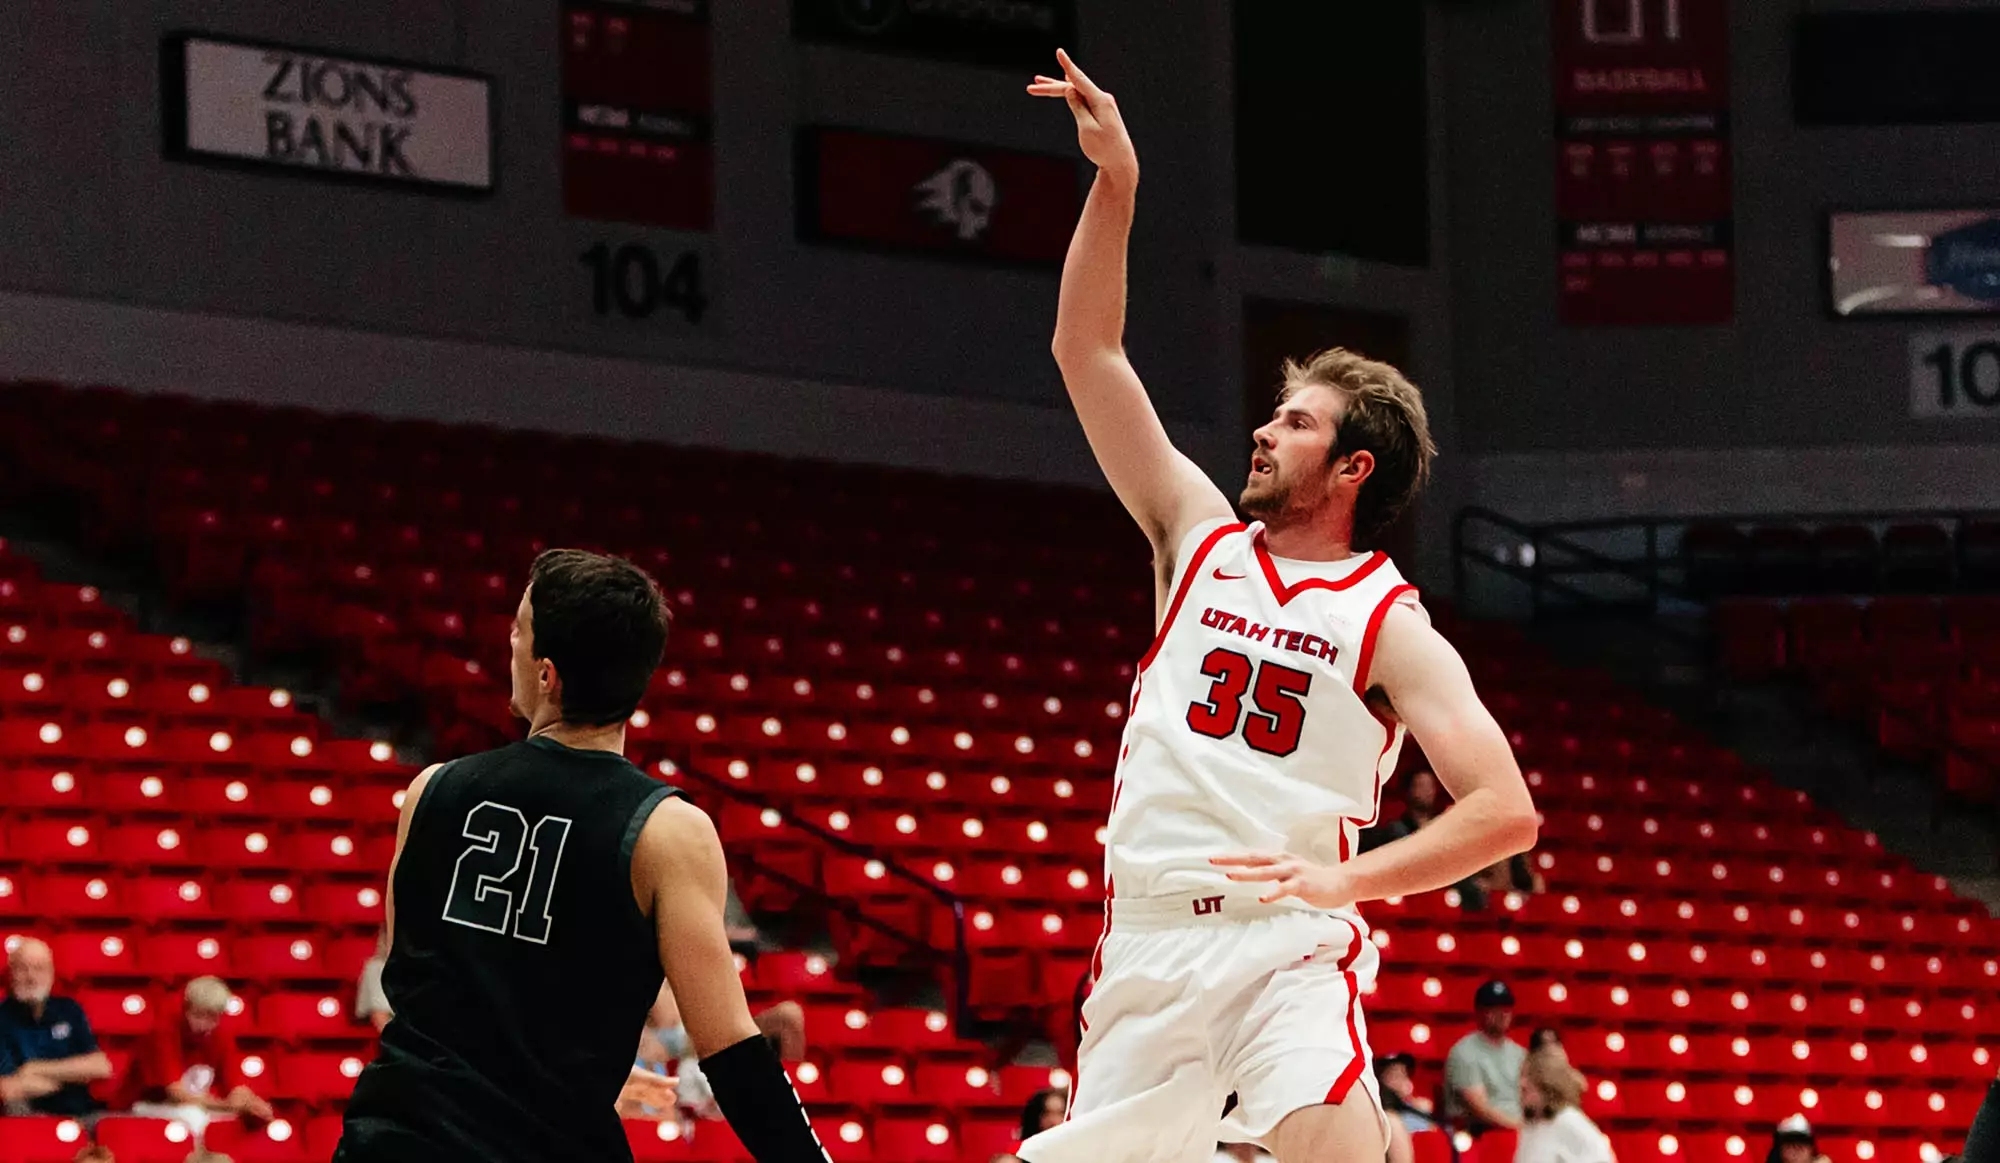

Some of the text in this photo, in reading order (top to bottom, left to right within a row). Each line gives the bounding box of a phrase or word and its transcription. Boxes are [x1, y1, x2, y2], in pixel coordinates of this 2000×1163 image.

[263, 54, 417, 117] ZIONS
[265, 111, 415, 177] BANK
[580, 241, 707, 321] 104
[1200, 606, 1340, 666] UTAH TECH
[1187, 647, 1312, 758] 35
[442, 800, 572, 945] 21
[1192, 895, 1225, 916] UT
